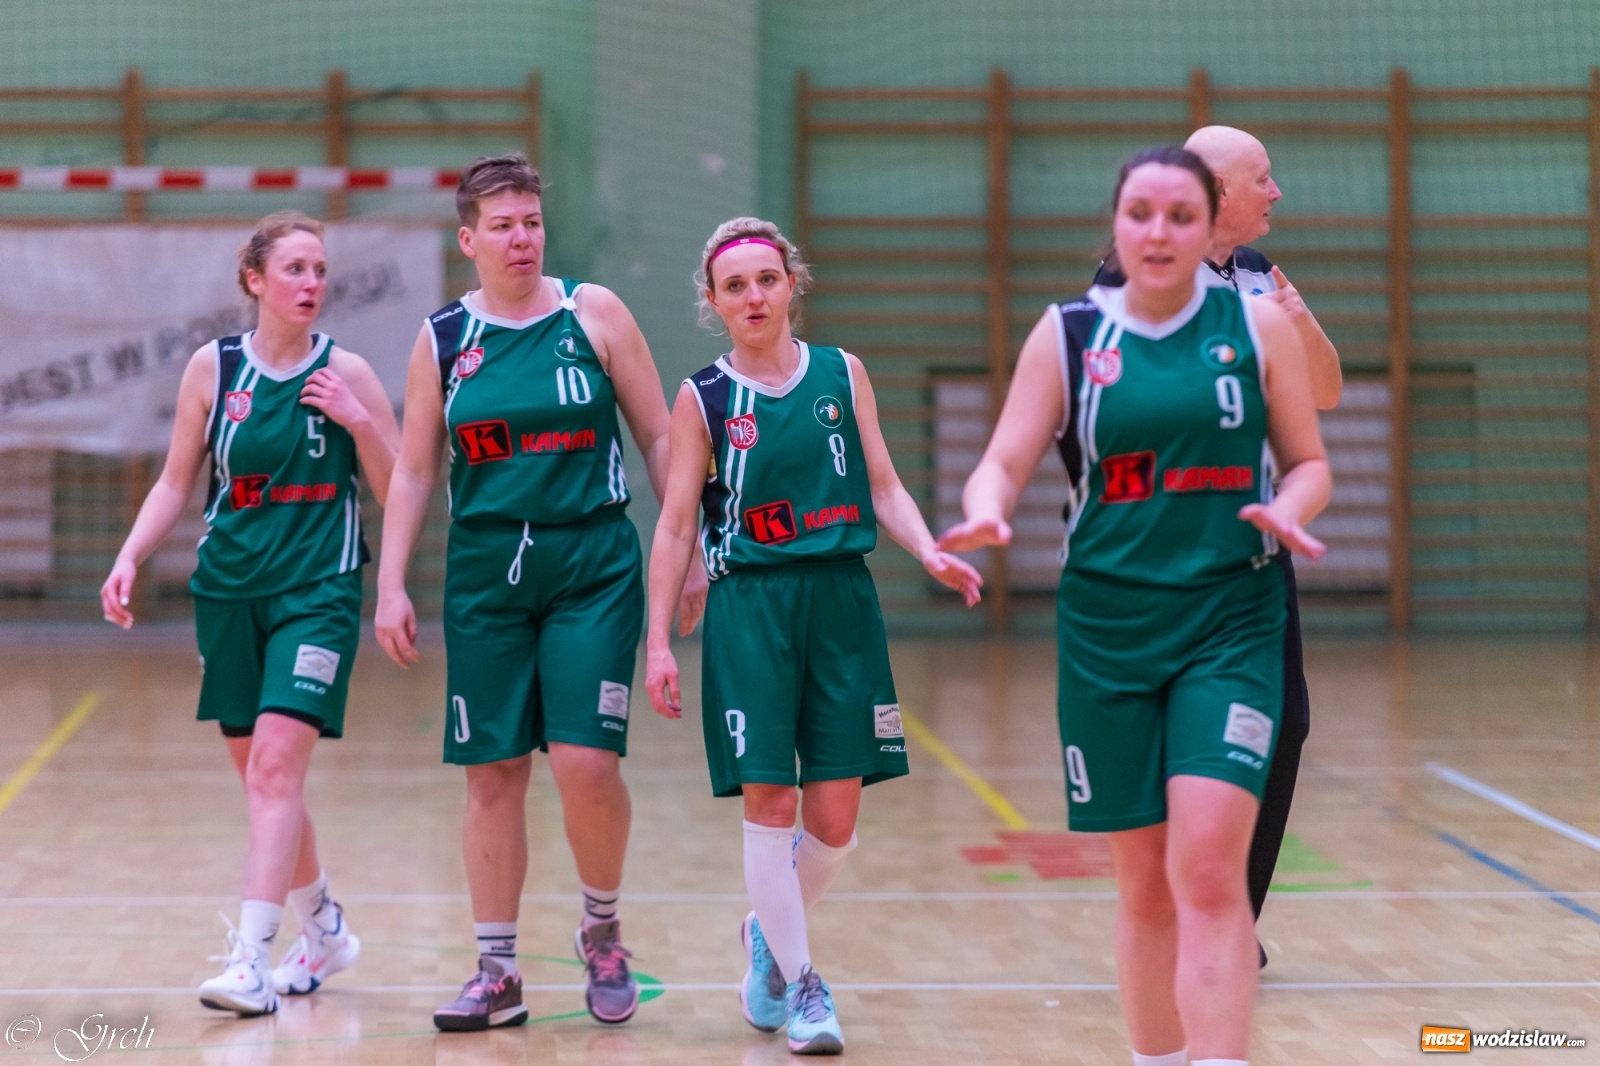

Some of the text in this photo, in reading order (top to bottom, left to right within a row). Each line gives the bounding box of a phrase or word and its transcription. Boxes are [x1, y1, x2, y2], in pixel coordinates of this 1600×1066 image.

[556, 366, 592, 405] 10
[1215, 375, 1244, 429] 9
[307, 415, 325, 458] 5
[520, 429, 596, 453] KAMAN
[828, 433, 846, 477] 8
[270, 483, 336, 502] KAMAN
[1163, 466, 1253, 492] KAMAN
[1066, 744, 1092, 803] 9
